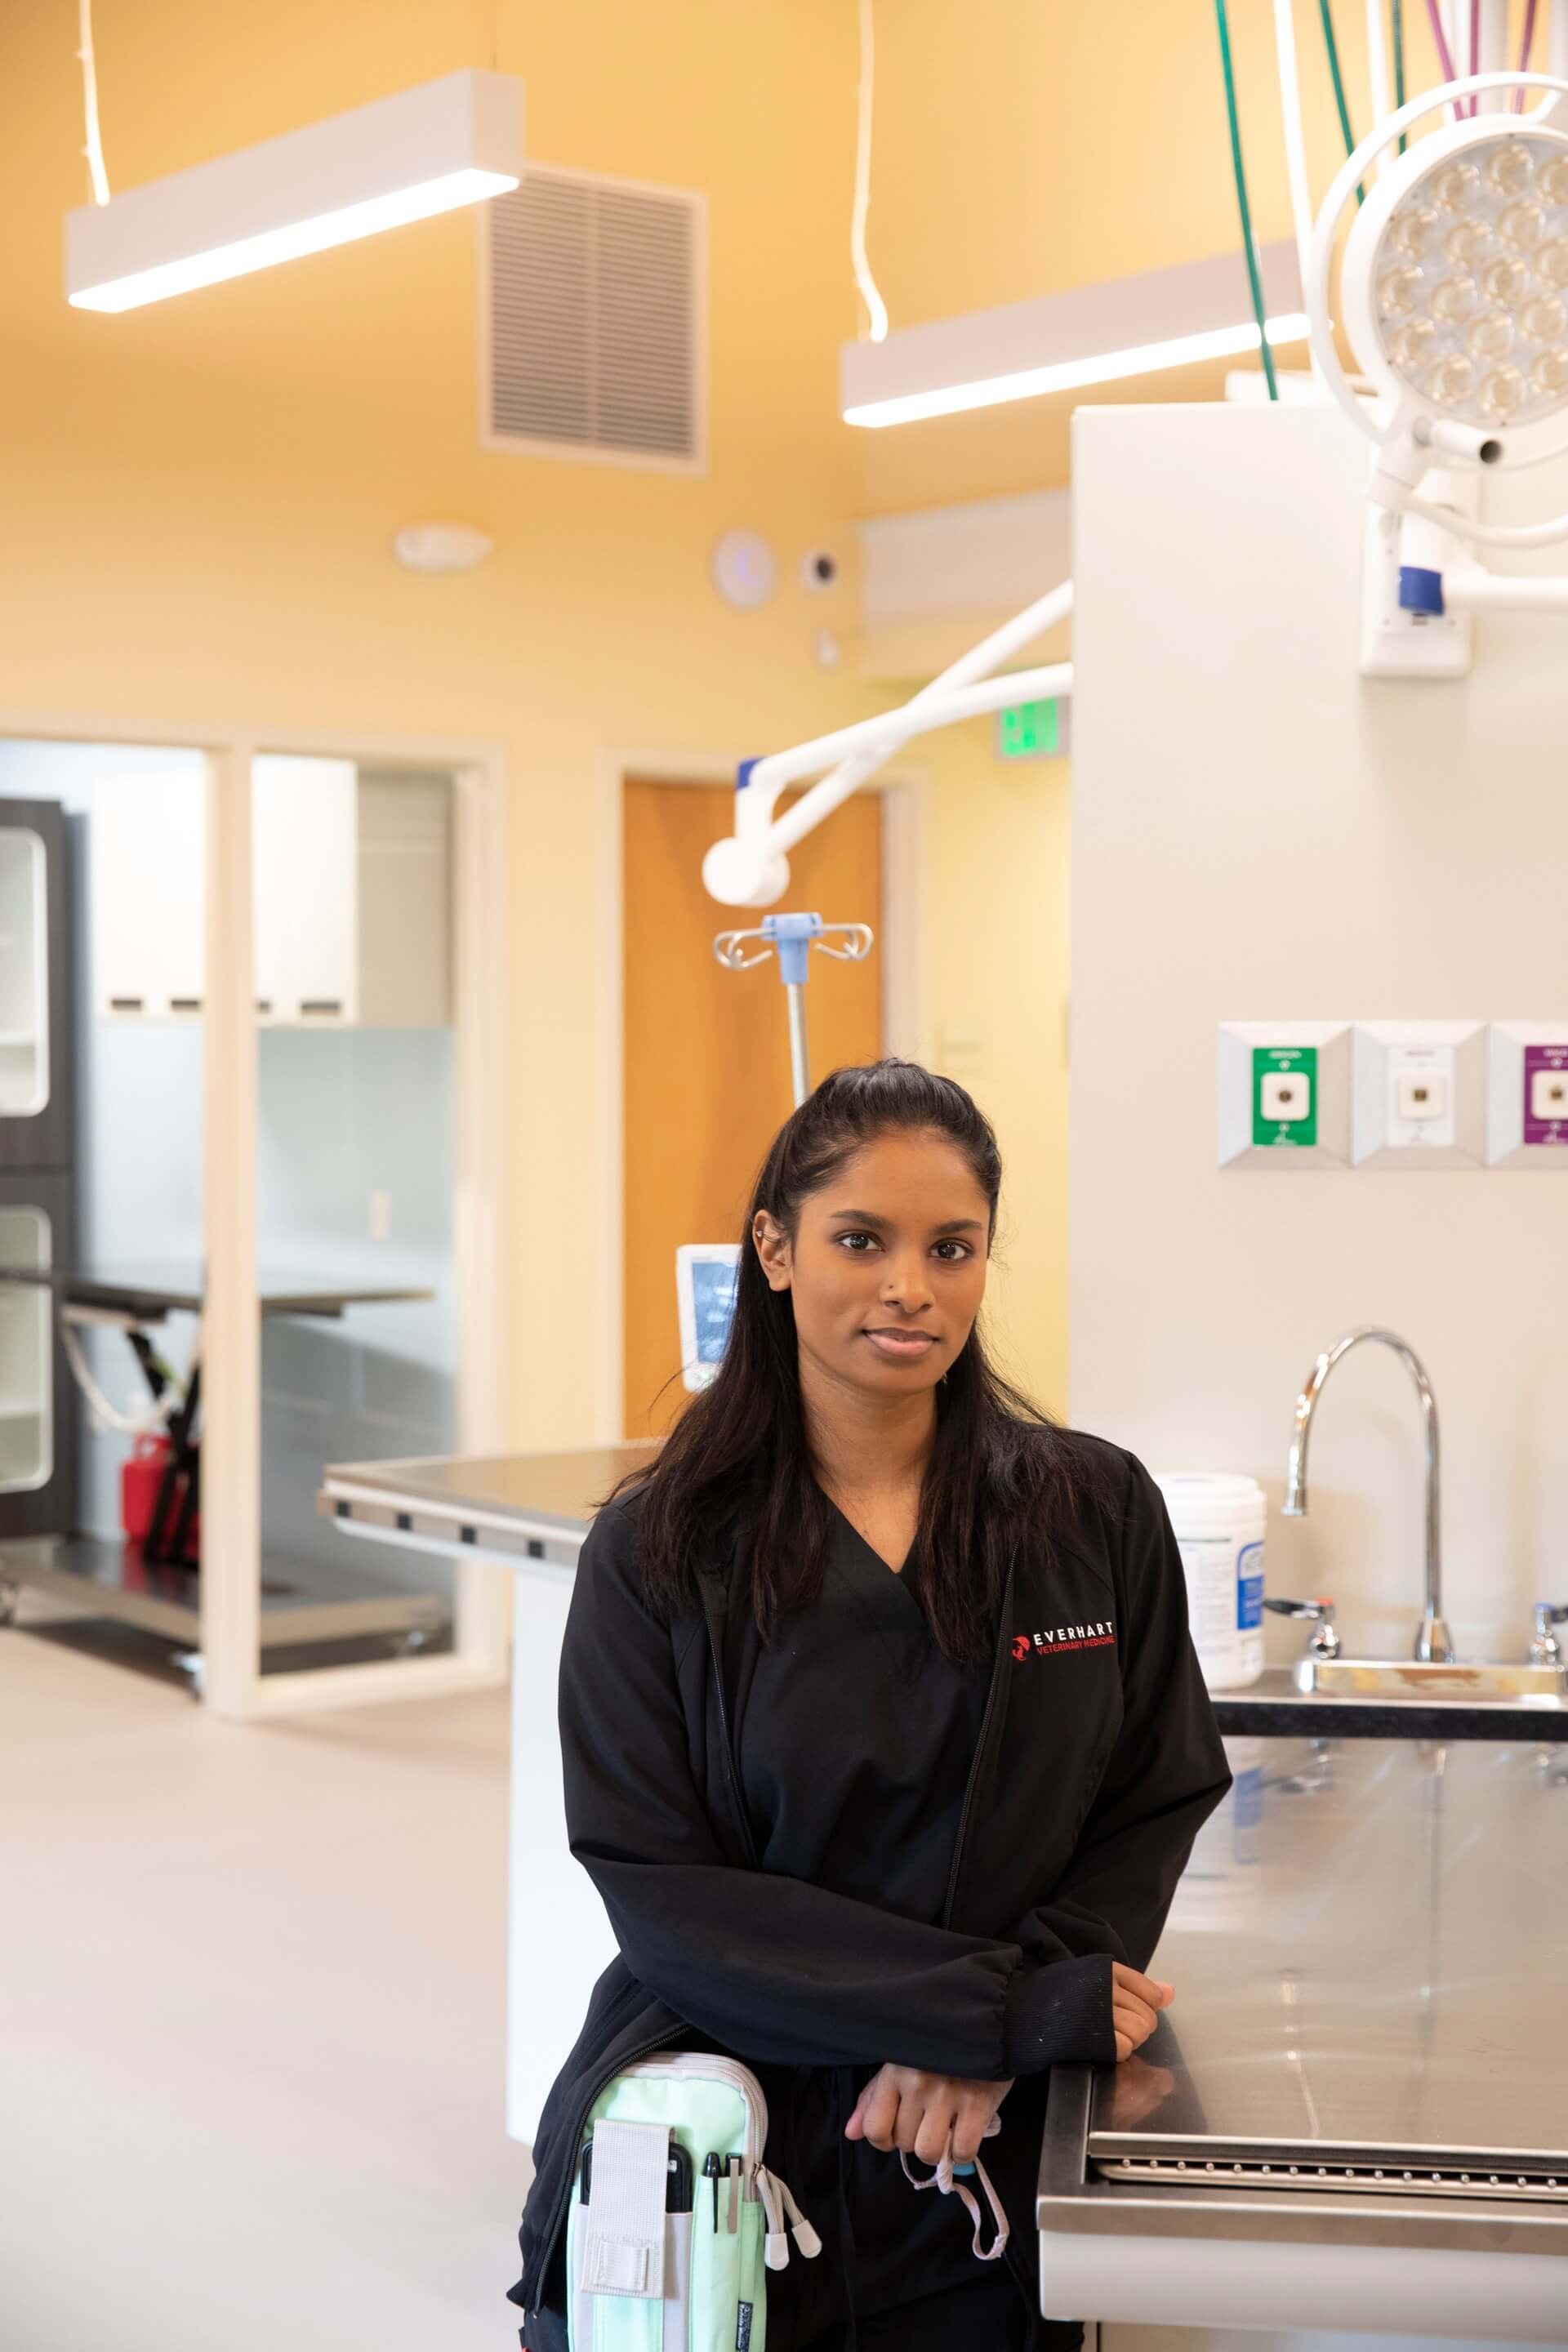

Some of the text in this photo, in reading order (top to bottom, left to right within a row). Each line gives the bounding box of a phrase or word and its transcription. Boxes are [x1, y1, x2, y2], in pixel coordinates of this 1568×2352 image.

[1033, 1622, 1113, 1646] EVERHART
[1037, 1636, 1116, 1655] VETERINARY MEDICINE
